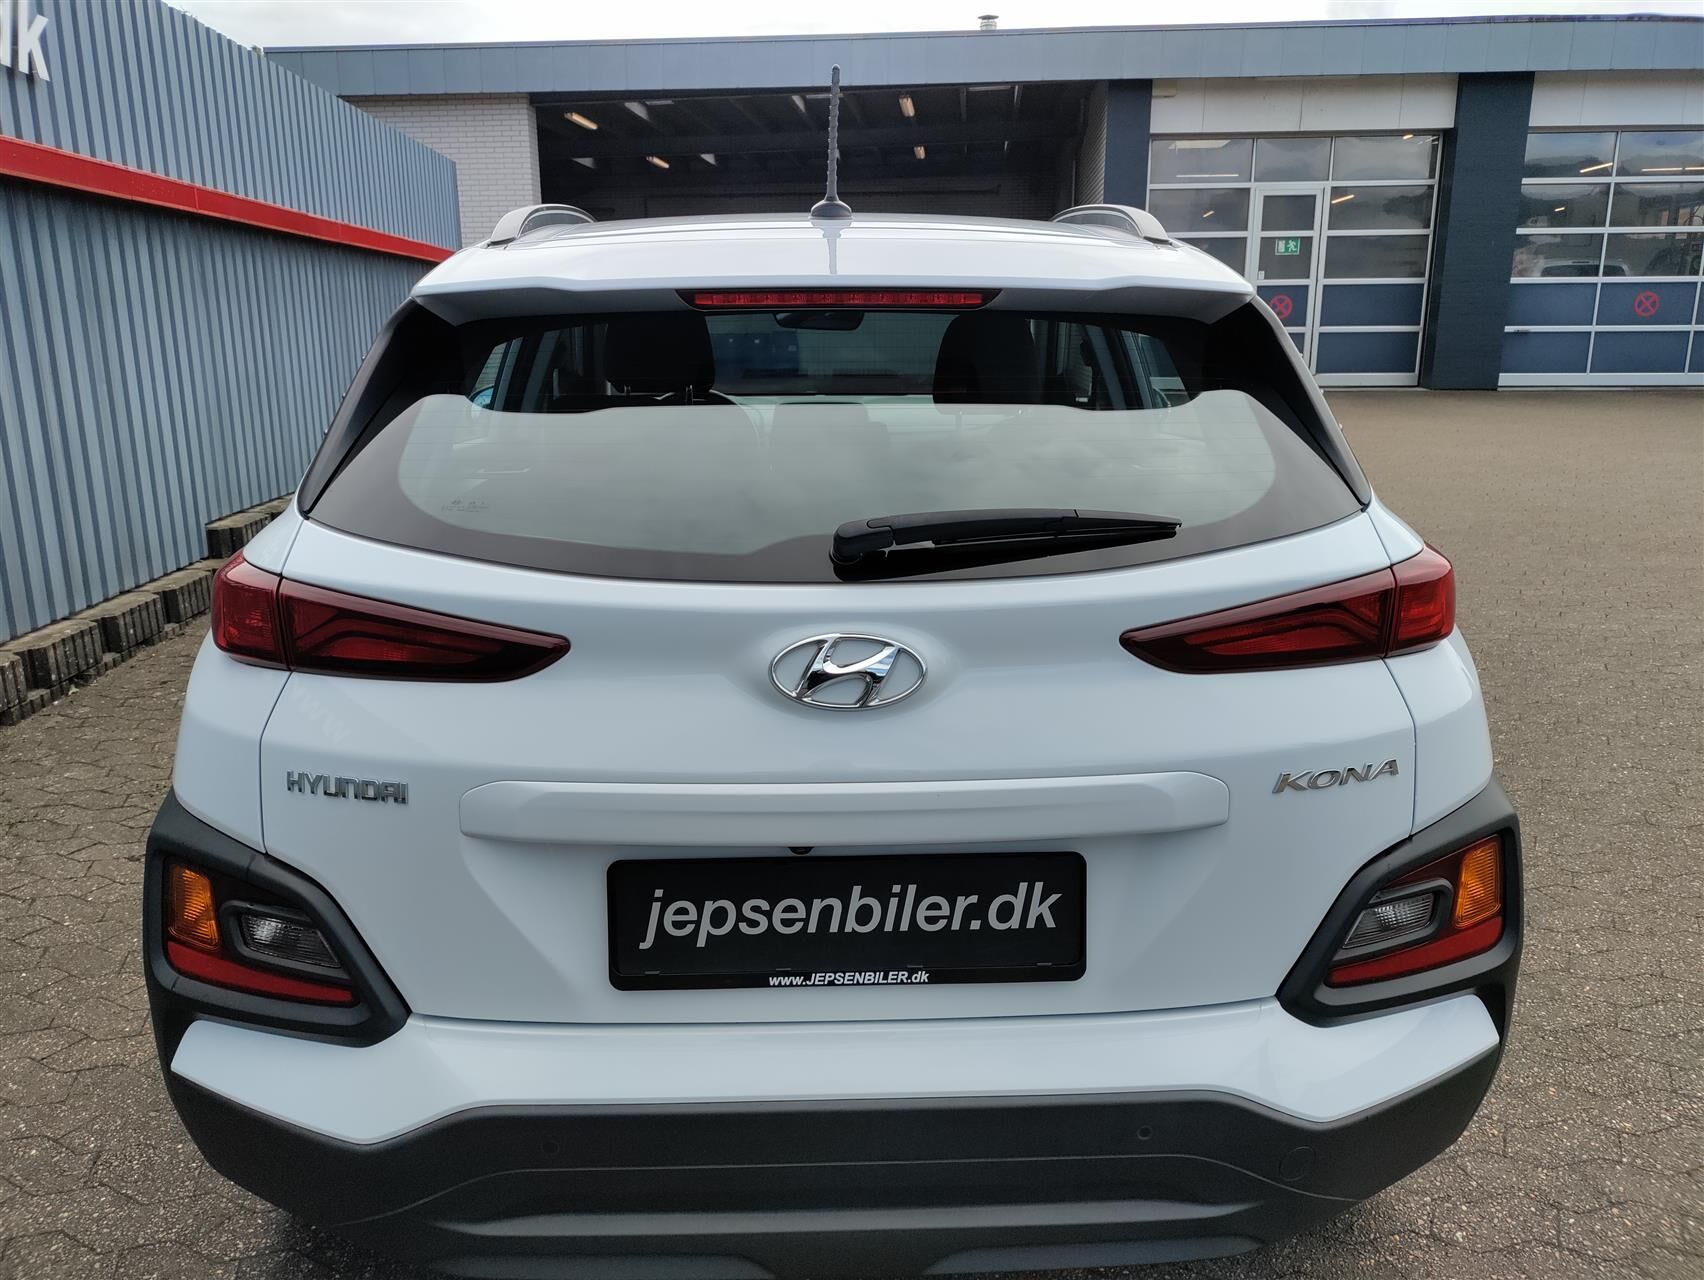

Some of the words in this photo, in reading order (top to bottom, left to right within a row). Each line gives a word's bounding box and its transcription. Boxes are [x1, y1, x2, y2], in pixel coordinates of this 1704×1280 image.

[286, 770, 409, 804] HYUNDAI
[1272, 758, 1399, 794] KONA
[638, 881, 1062, 950] jepsenbiler.dk
[768, 970, 929, 986] www.JEPSENBILER.dk
